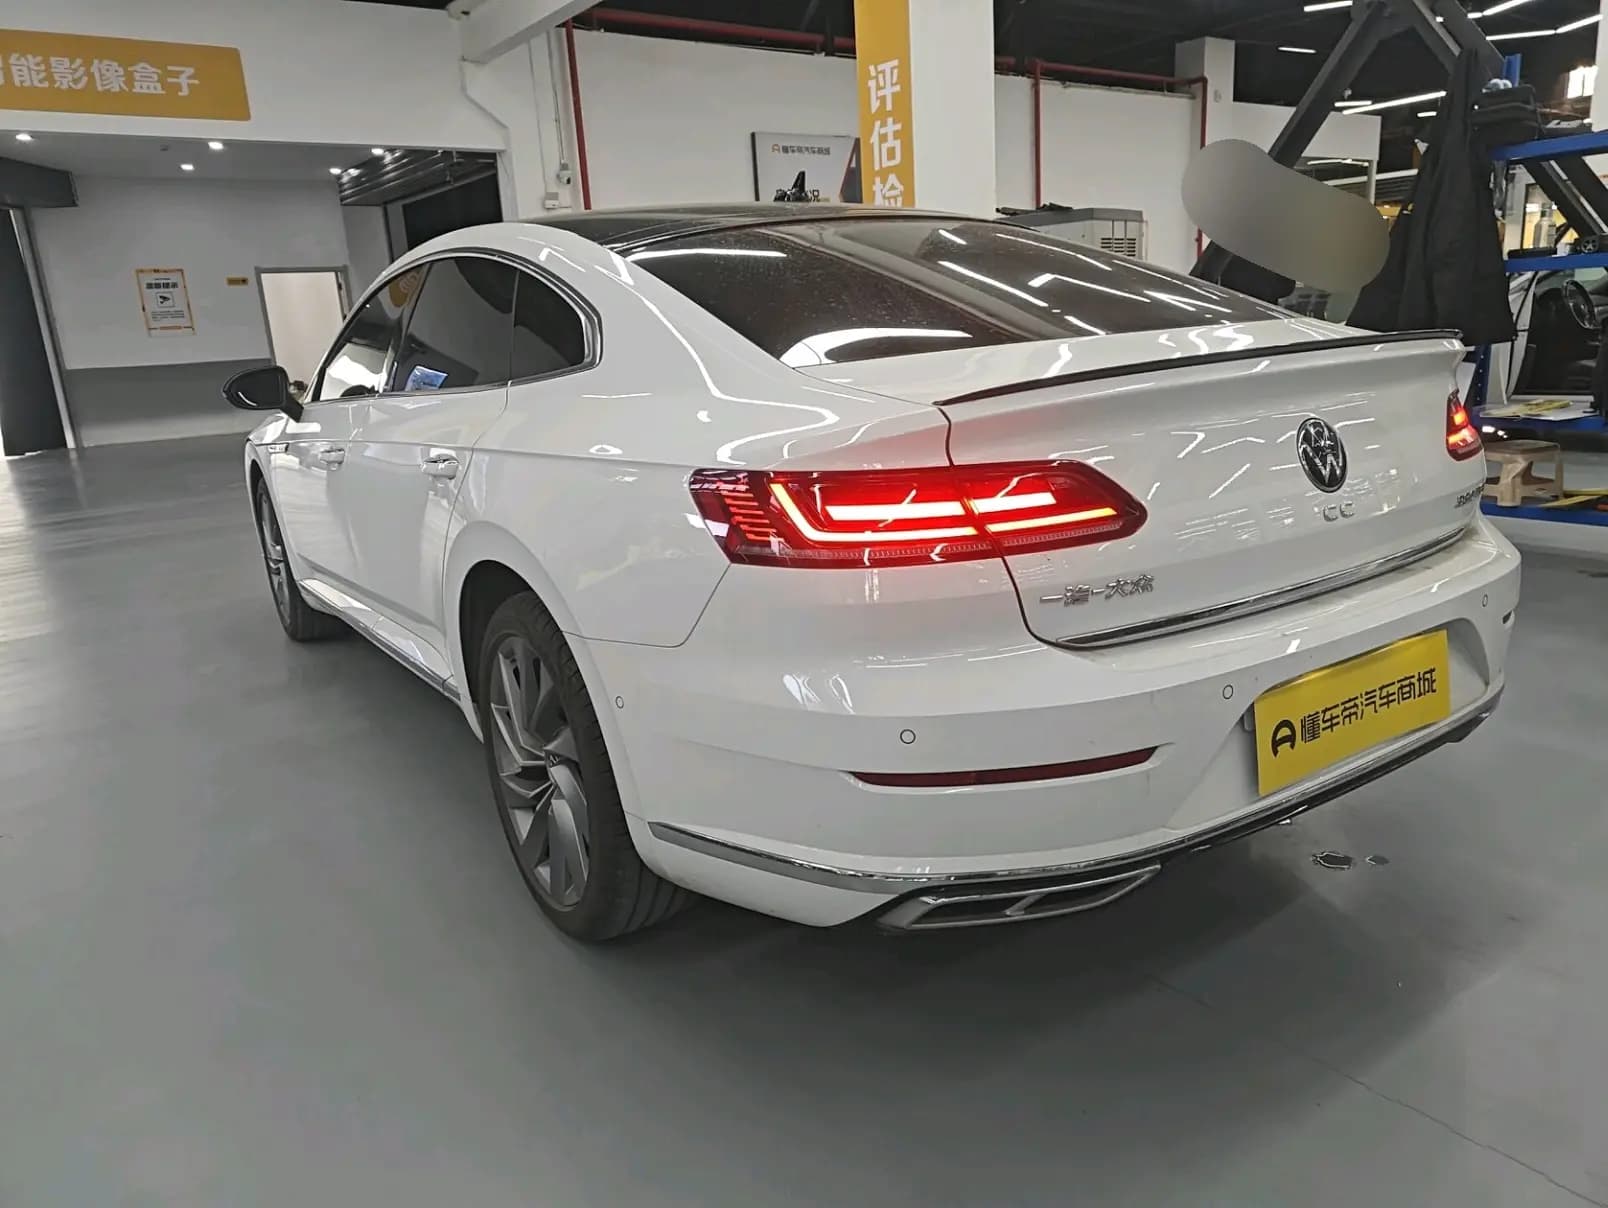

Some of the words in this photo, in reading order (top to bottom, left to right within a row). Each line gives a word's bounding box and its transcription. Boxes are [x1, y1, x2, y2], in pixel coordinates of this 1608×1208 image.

[0, 53, 200, 97] 能影像盒子
[1322, 500, 1355, 522] CC
[1300, 667, 1437, 744] 懂车帝汽车商城
